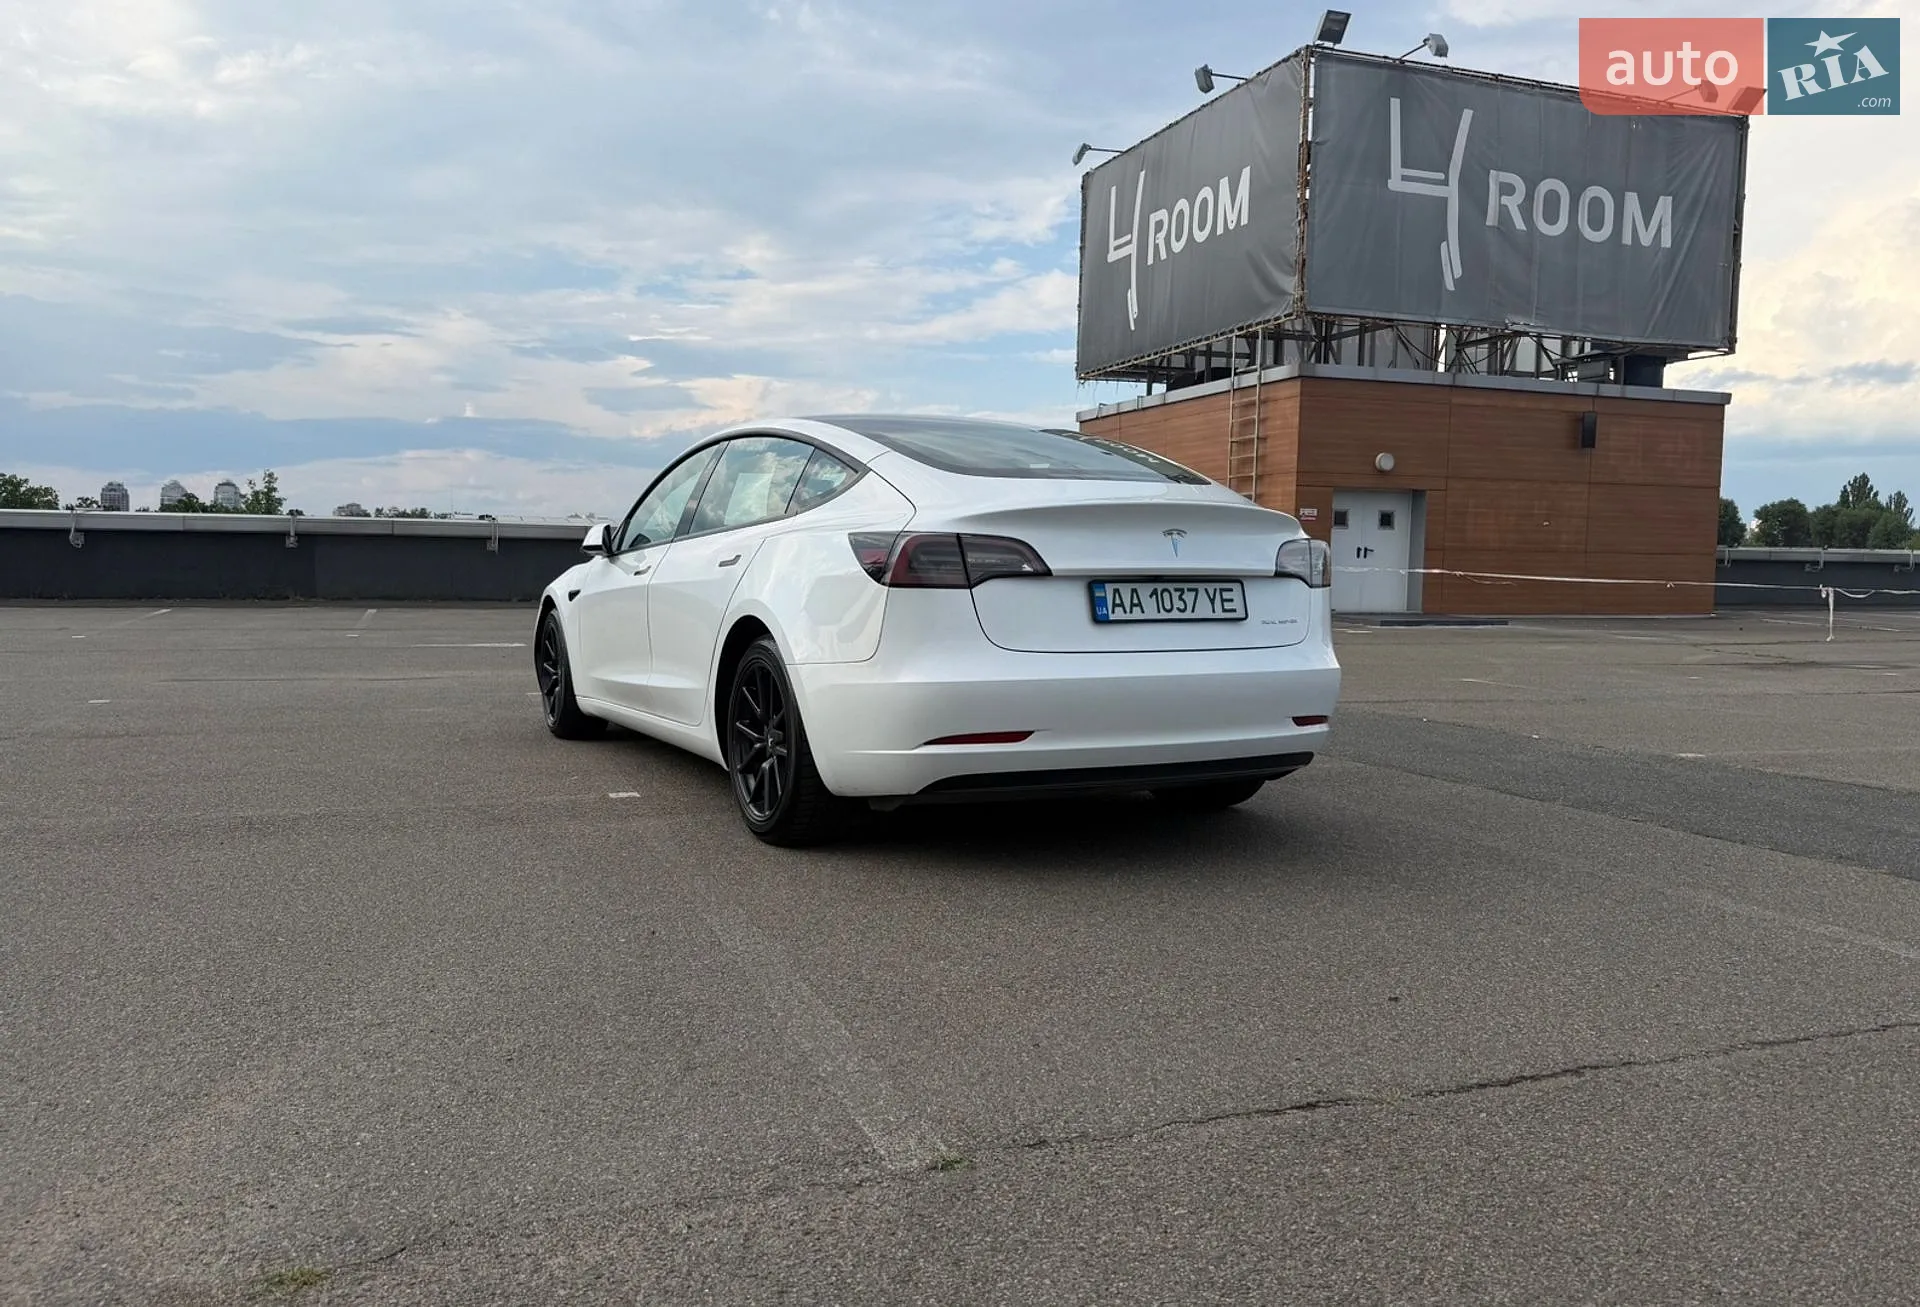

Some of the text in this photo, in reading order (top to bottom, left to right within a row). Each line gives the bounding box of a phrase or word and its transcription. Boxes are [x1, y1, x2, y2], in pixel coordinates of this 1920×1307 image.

[1147, 165, 1251, 266] ROOM
[1485, 169, 1674, 249] ROOM
[1111, 587, 1237, 614] AA 1037 YE
